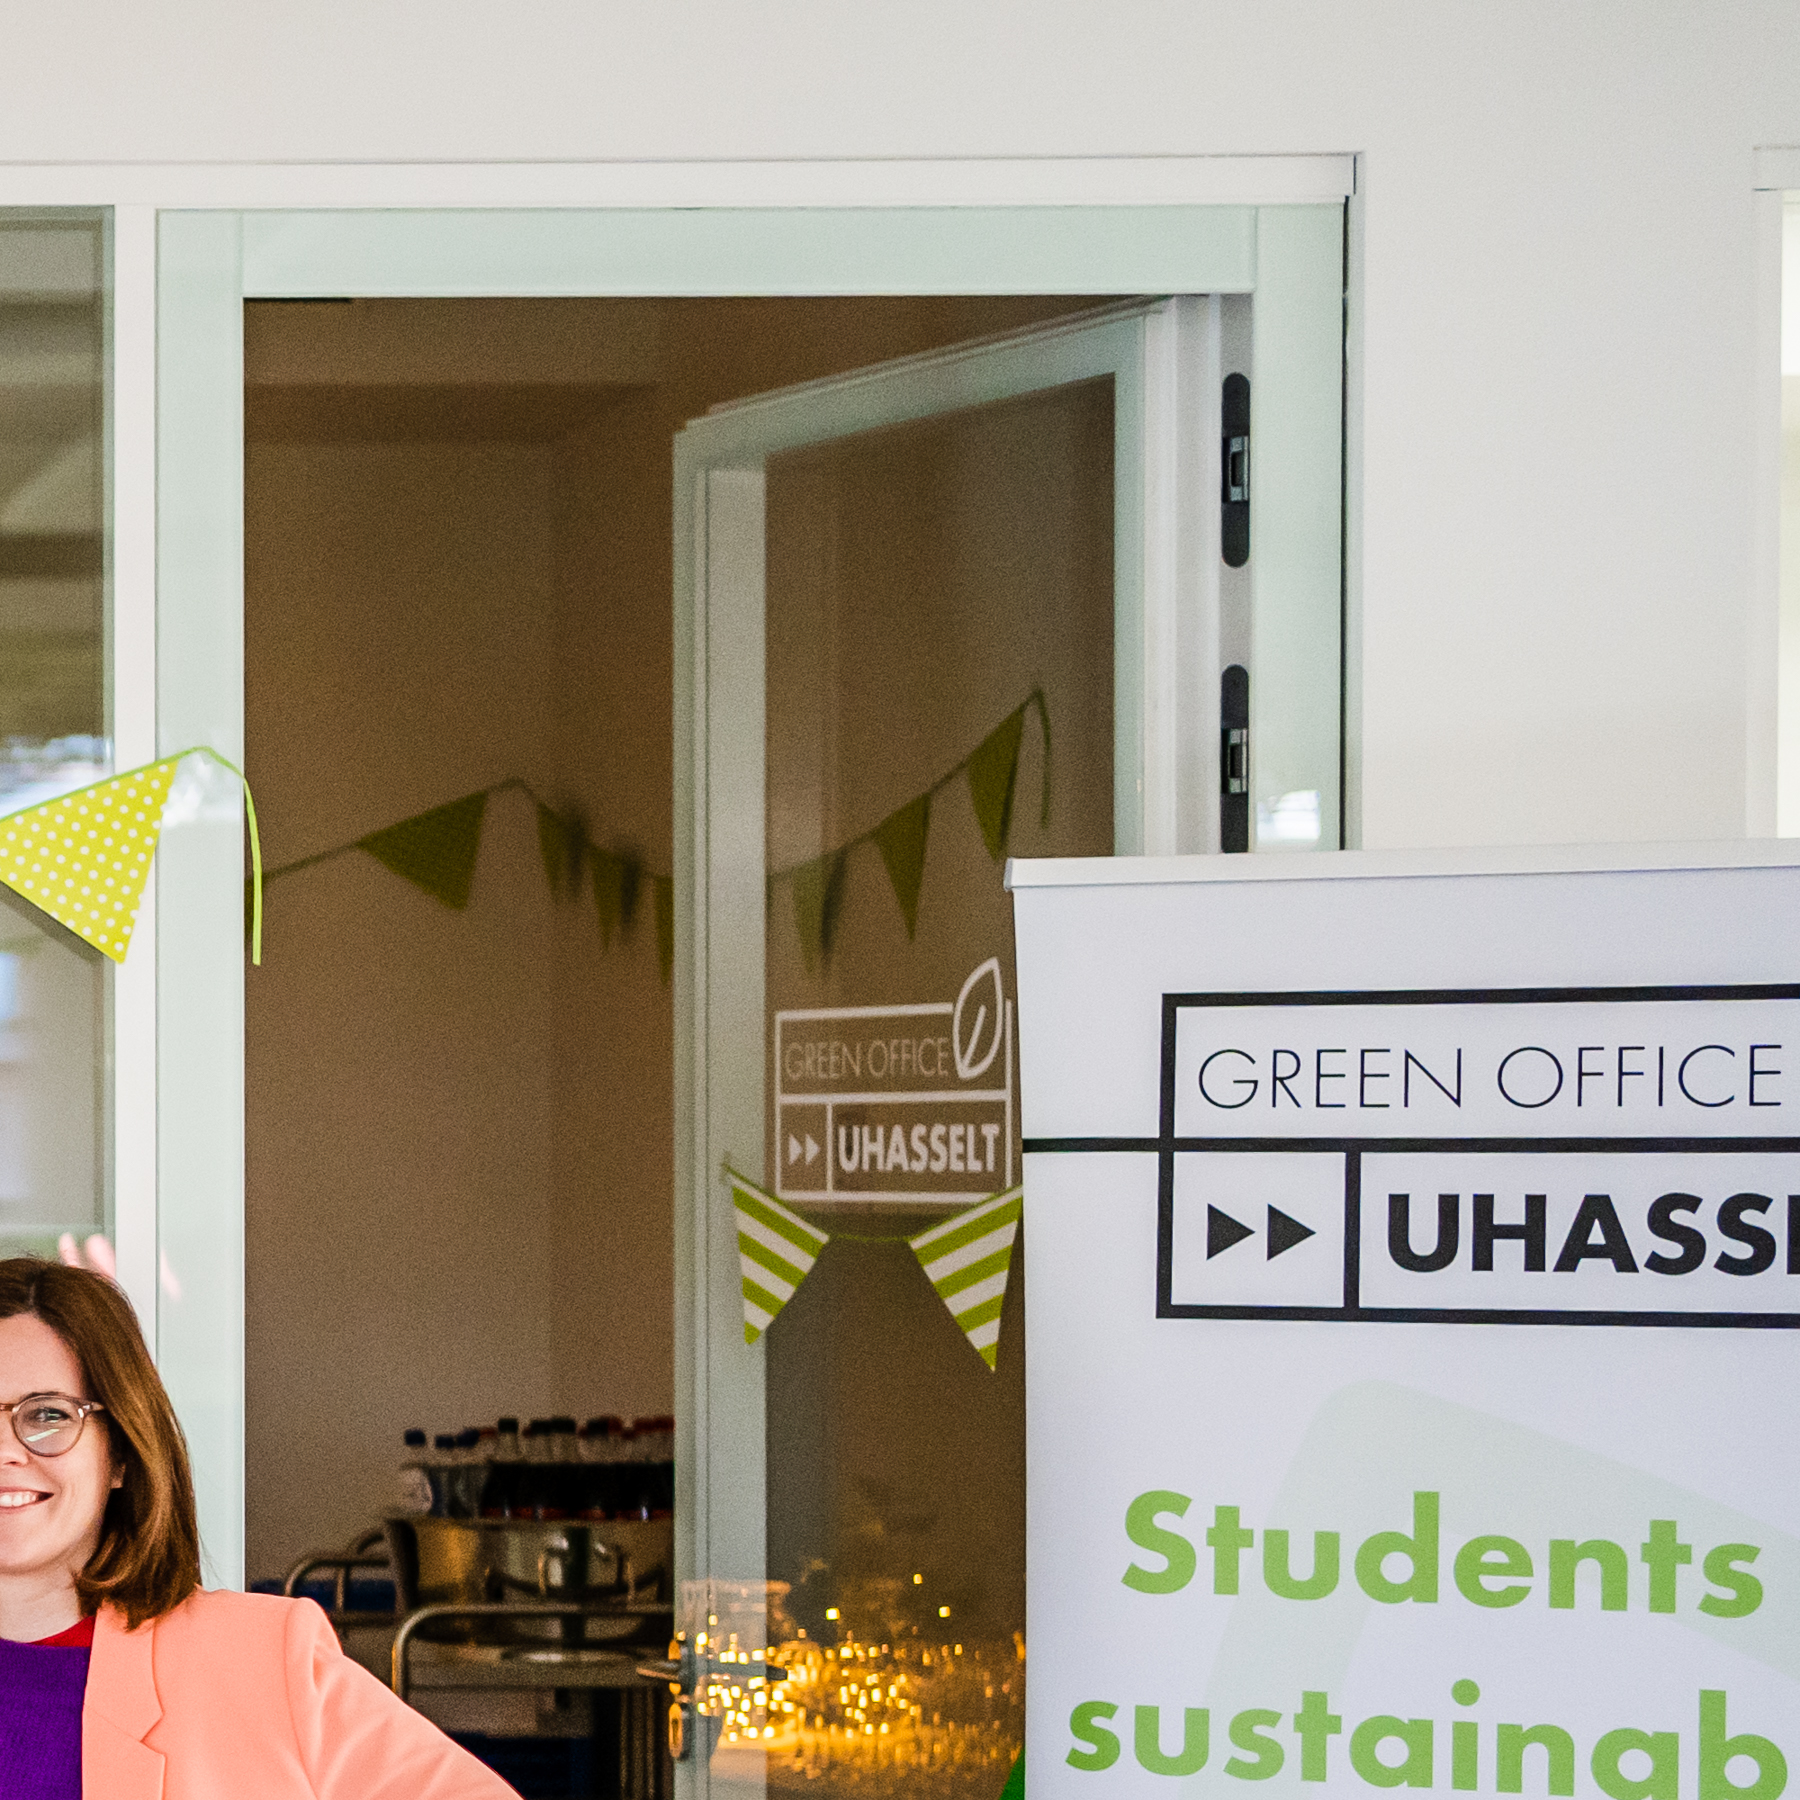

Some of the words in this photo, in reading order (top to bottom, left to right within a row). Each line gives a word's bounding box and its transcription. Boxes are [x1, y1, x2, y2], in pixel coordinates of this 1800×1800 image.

[784, 1041, 861, 1080] GREEN
[867, 1037, 949, 1078] OFFICE
[1198, 1048, 1463, 1109] GREEN
[1497, 1044, 1783, 1108] OFFICE
[838, 1123, 999, 1173] UHASSELT
[1387, 1192, 1800, 1277] UHASS
[1121, 1490, 1763, 1619] Students
